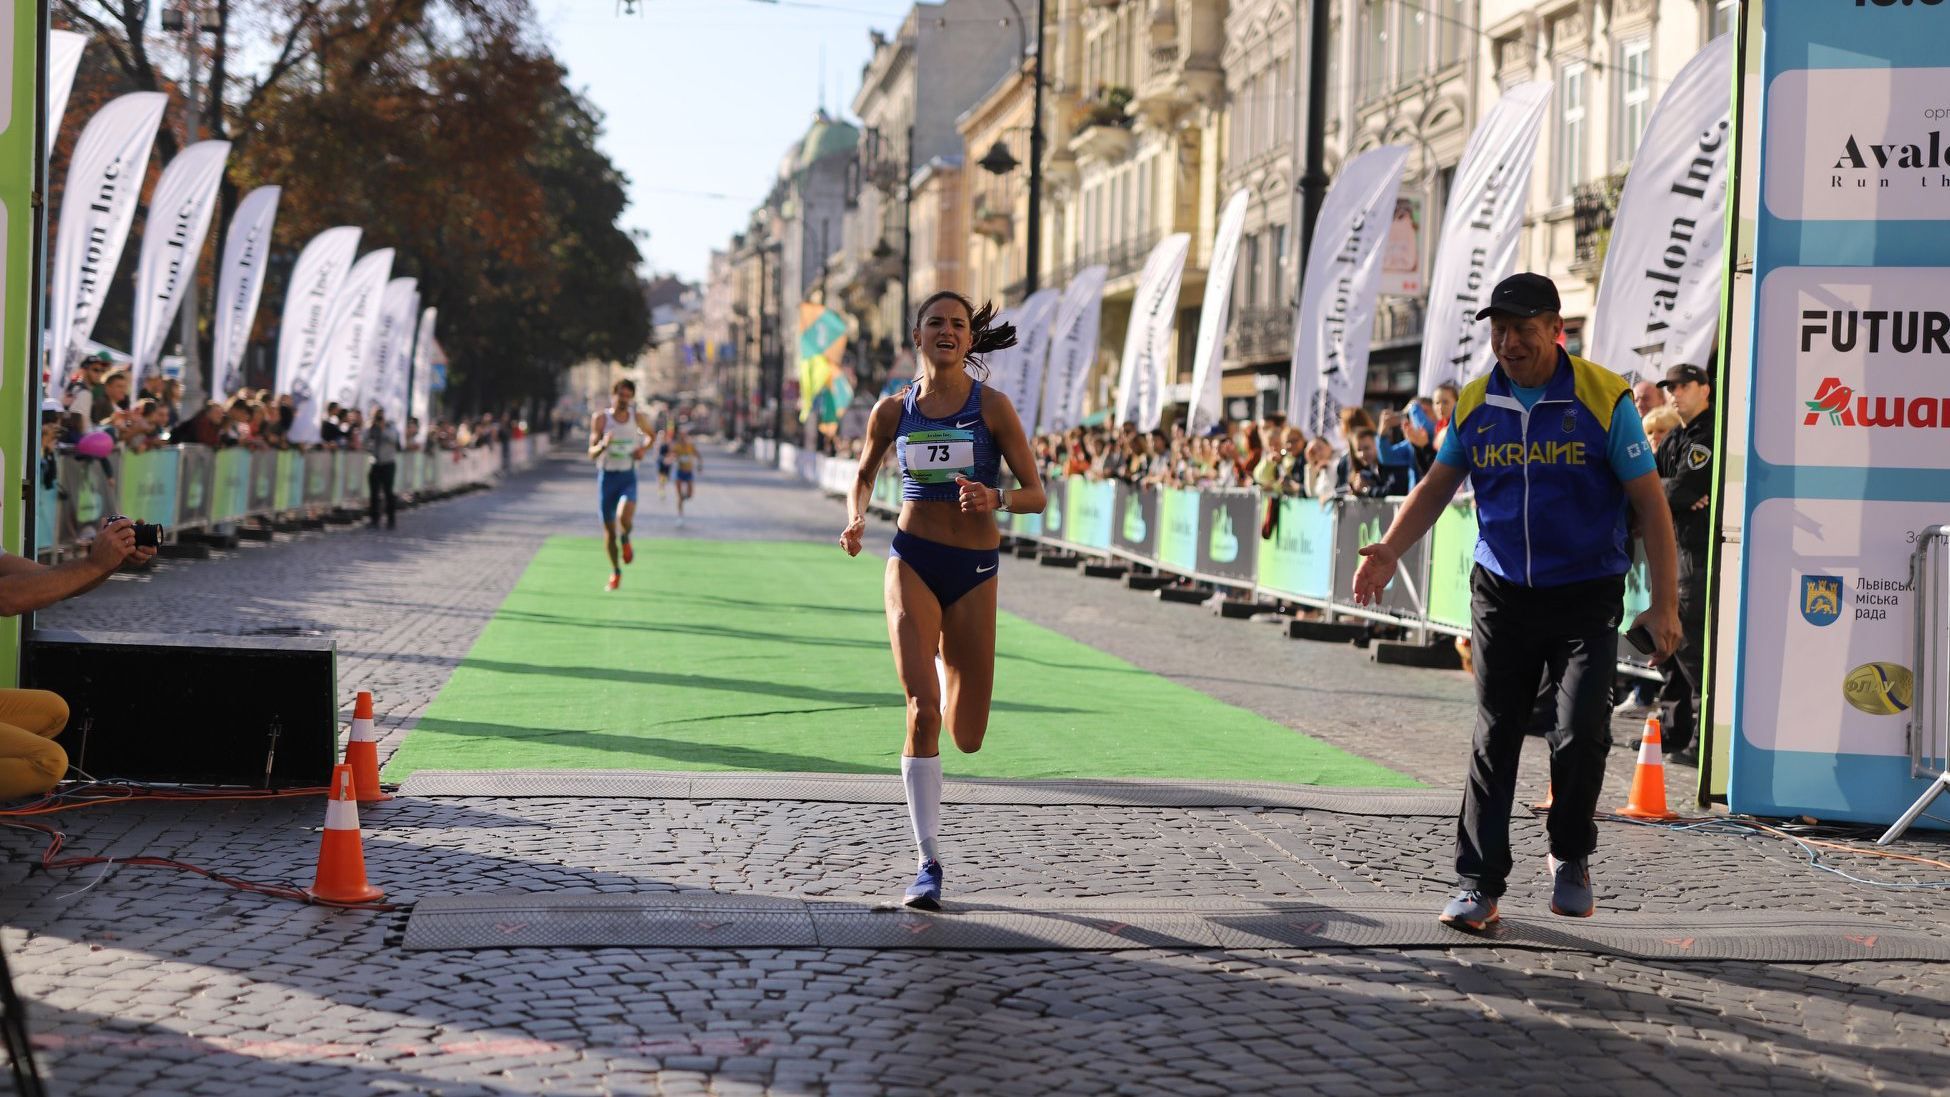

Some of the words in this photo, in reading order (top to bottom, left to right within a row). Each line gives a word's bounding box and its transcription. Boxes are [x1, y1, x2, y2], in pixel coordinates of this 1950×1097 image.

[1831, 175, 1889, 188] Run
[1632, 216, 1697, 372] Avalon
[1670, 120, 1729, 199] Inc.
[1451, 249, 1486, 374] Avalon
[927, 445, 950, 462] 73
[1472, 441, 1586, 468] UKRAINE
[1856, 577, 1916, 592] Львівськ
[1856, 592, 1898, 606] міська
[1855, 608, 1886, 621] рада
